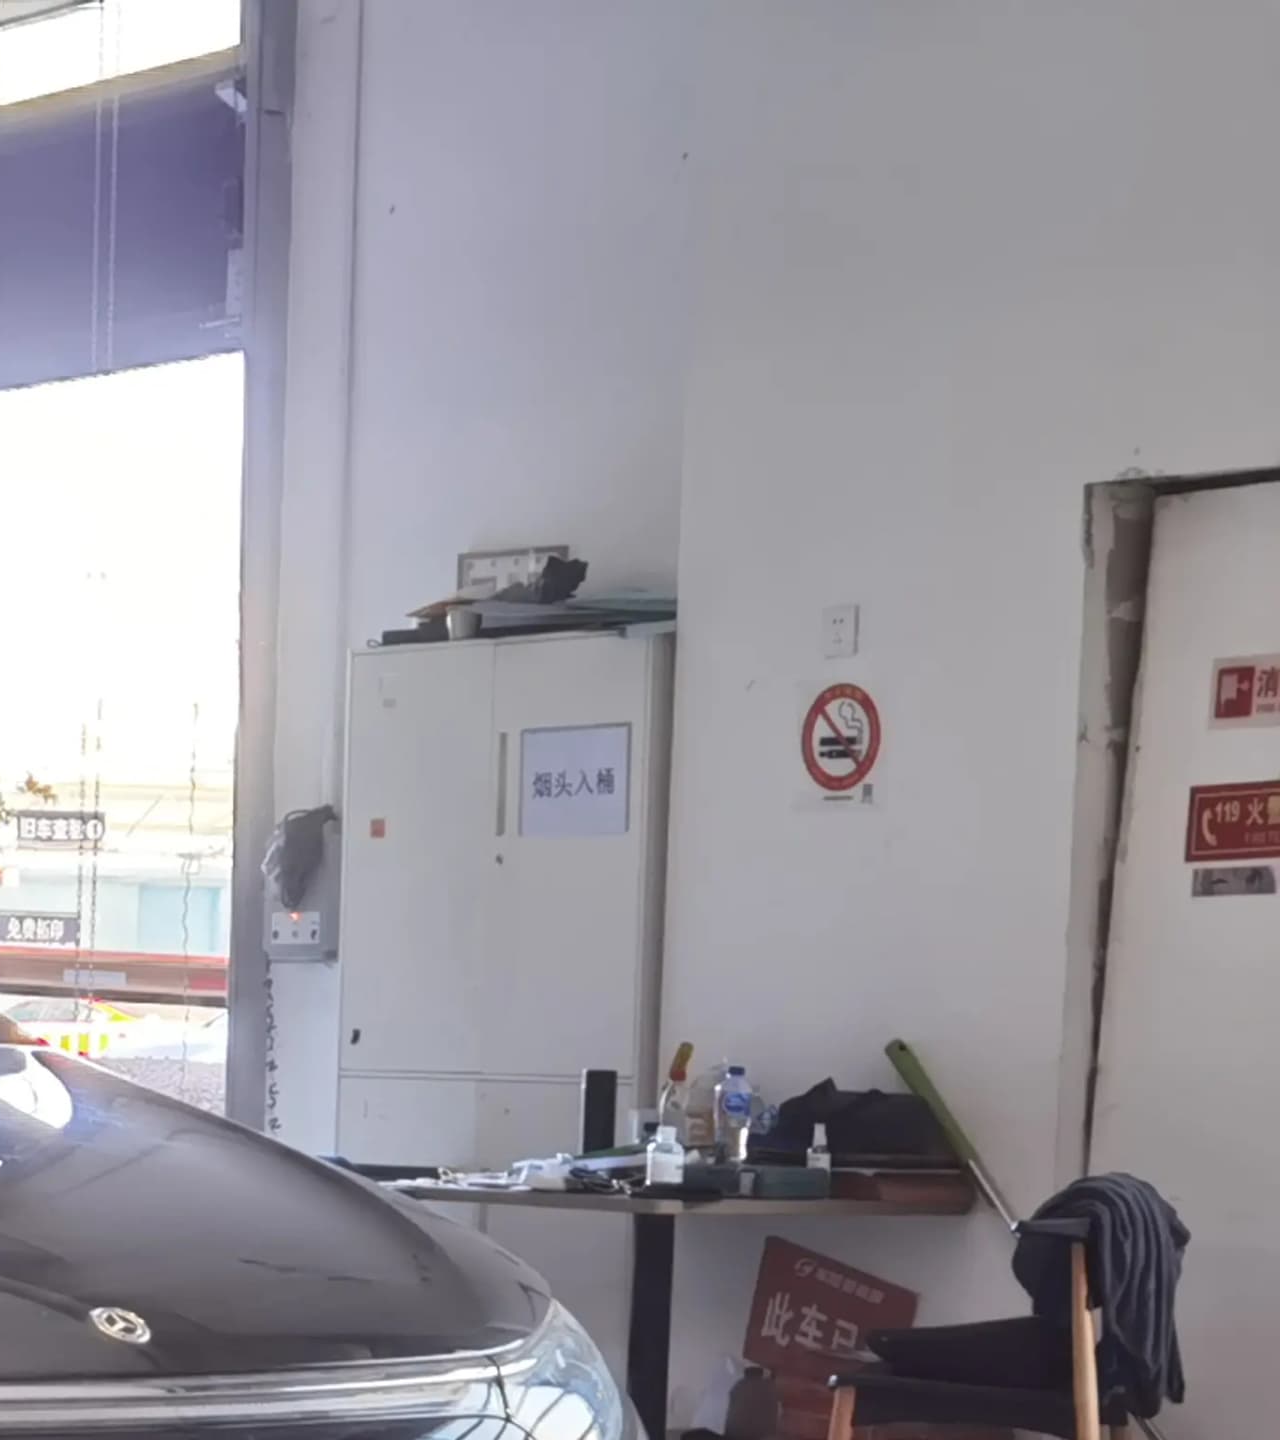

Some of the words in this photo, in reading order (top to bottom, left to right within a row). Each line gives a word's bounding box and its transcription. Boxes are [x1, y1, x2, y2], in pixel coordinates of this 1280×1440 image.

[532, 767, 615, 799] 烟头入桶
[1215, 800, 1241, 823] 119
